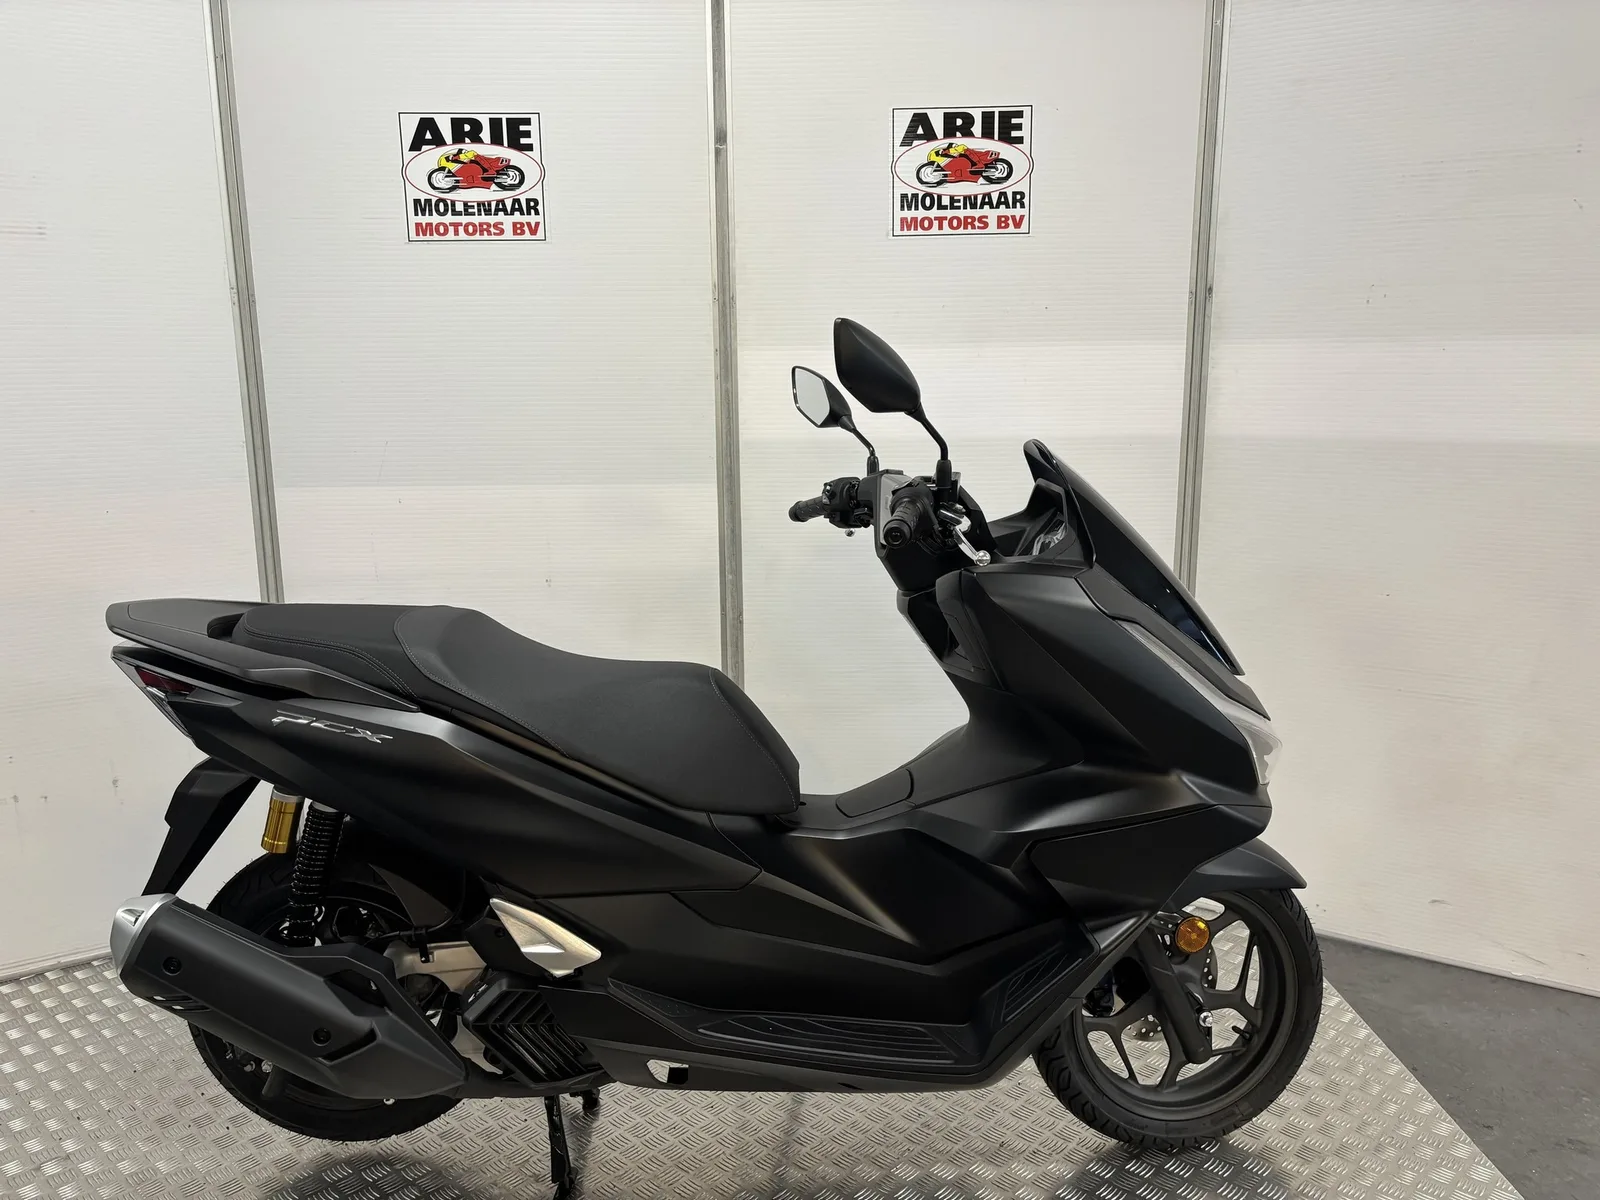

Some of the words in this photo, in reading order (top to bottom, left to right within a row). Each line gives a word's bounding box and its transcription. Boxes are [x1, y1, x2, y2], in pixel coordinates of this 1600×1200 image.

[408, 117, 534, 152] ARIE
[899, 110, 1024, 147] ARIE
[413, 198, 540, 217] MOLENAAR
[900, 191, 1026, 211] MOLENAAR
[414, 221, 505, 237] MOTORS
[512, 221, 541, 236] BV
[900, 215, 989, 231] MOTORS
[996, 214, 1026, 230] BV
[271, 709, 393, 744] PCX
